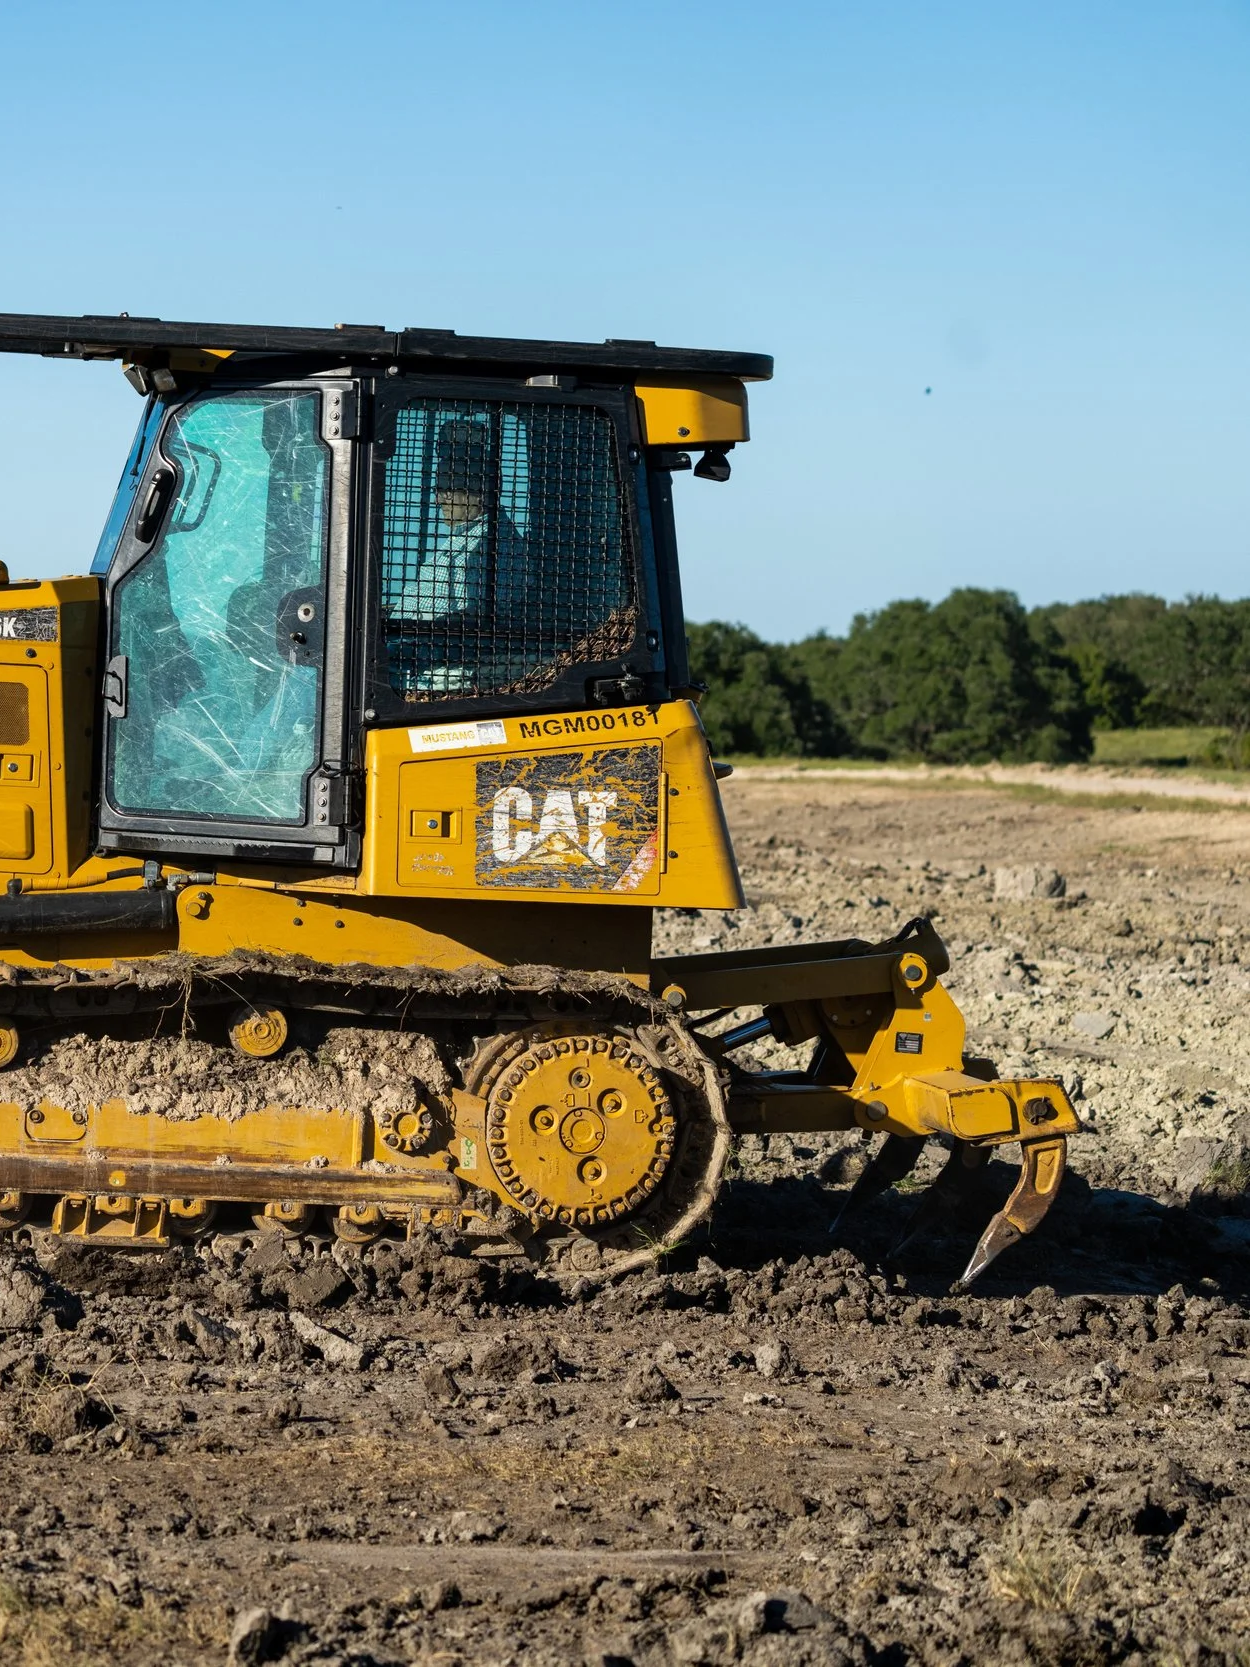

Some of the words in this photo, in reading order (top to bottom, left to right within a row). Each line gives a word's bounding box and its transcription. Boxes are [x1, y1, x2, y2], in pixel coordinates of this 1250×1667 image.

[422, 730, 475, 744] MUSTANG
[519, 709, 658, 738] MGM00181
[492, 786, 617, 867] CAT
